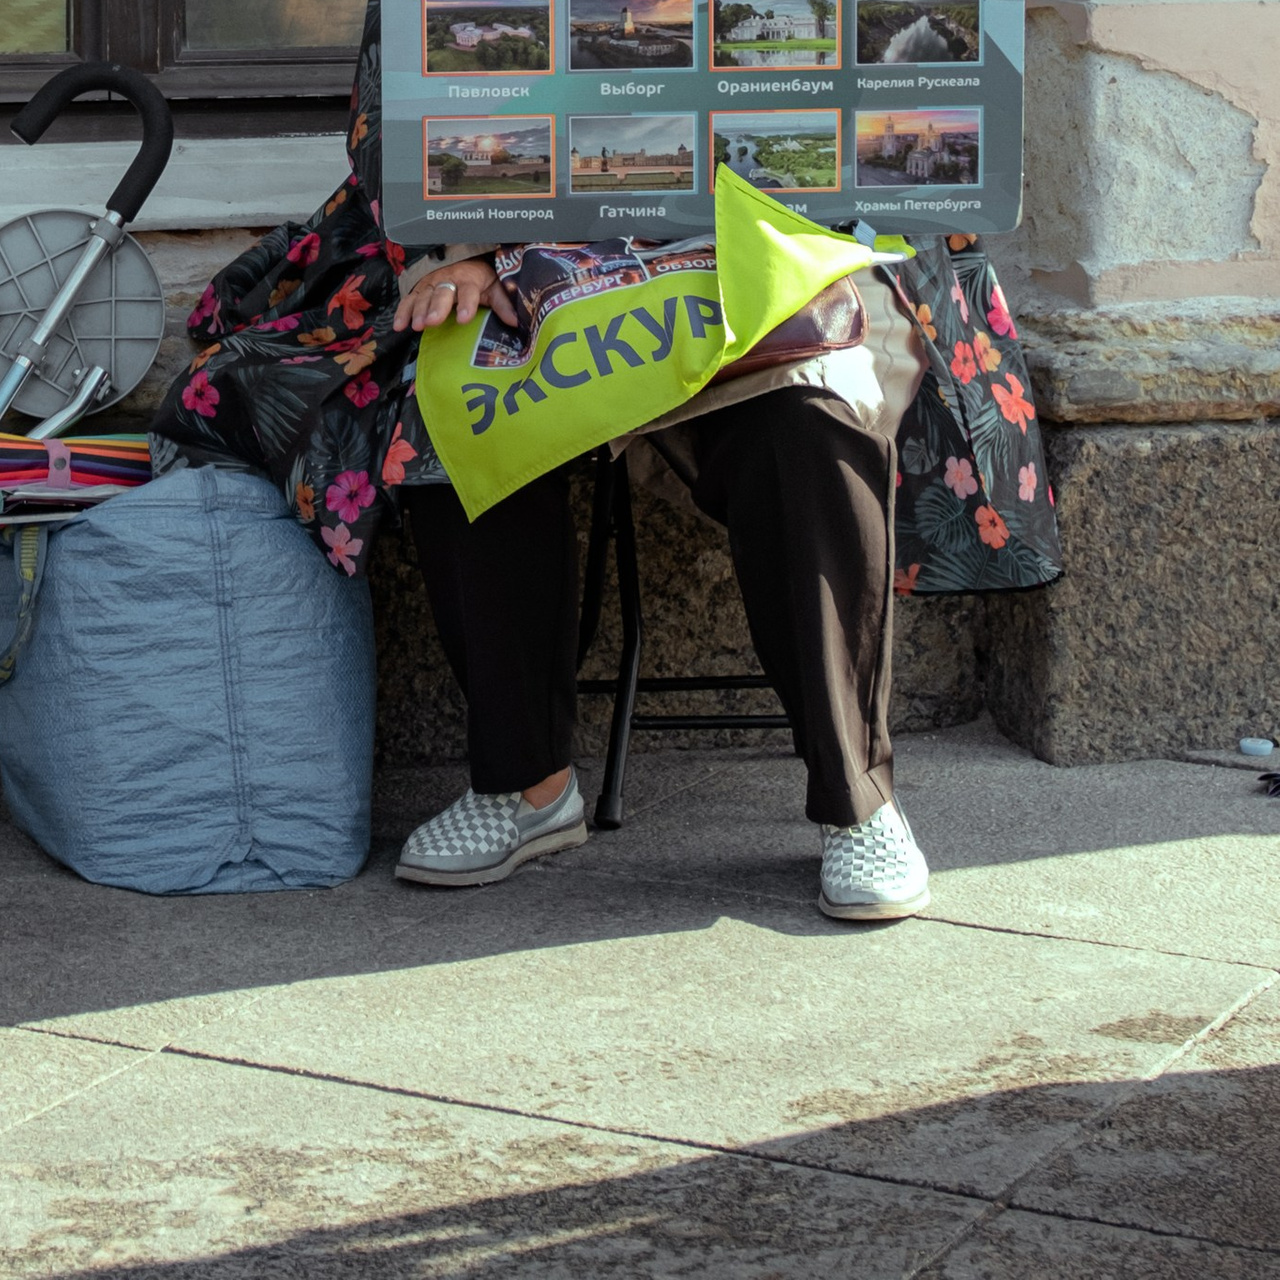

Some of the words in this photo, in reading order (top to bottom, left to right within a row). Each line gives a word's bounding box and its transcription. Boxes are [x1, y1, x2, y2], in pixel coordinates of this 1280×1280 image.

[600, 81, 666, 98] Выборг
[717, 78, 834, 95] Ораниенбаум
[857, 77, 915, 91] Карелия
[918, 75, 981, 90] Рускеала
[448, 85, 530, 98] Павловск
[599, 205, 667, 218] Гатчина
[855, 200, 901, 213] Храмы
[904, 198, 982, 212] Петербурга
[426, 207, 485, 221] Великий
[488, 207, 554, 221] Новгород
[538, 274, 624, 322] ПЕТЕРБУРГ
